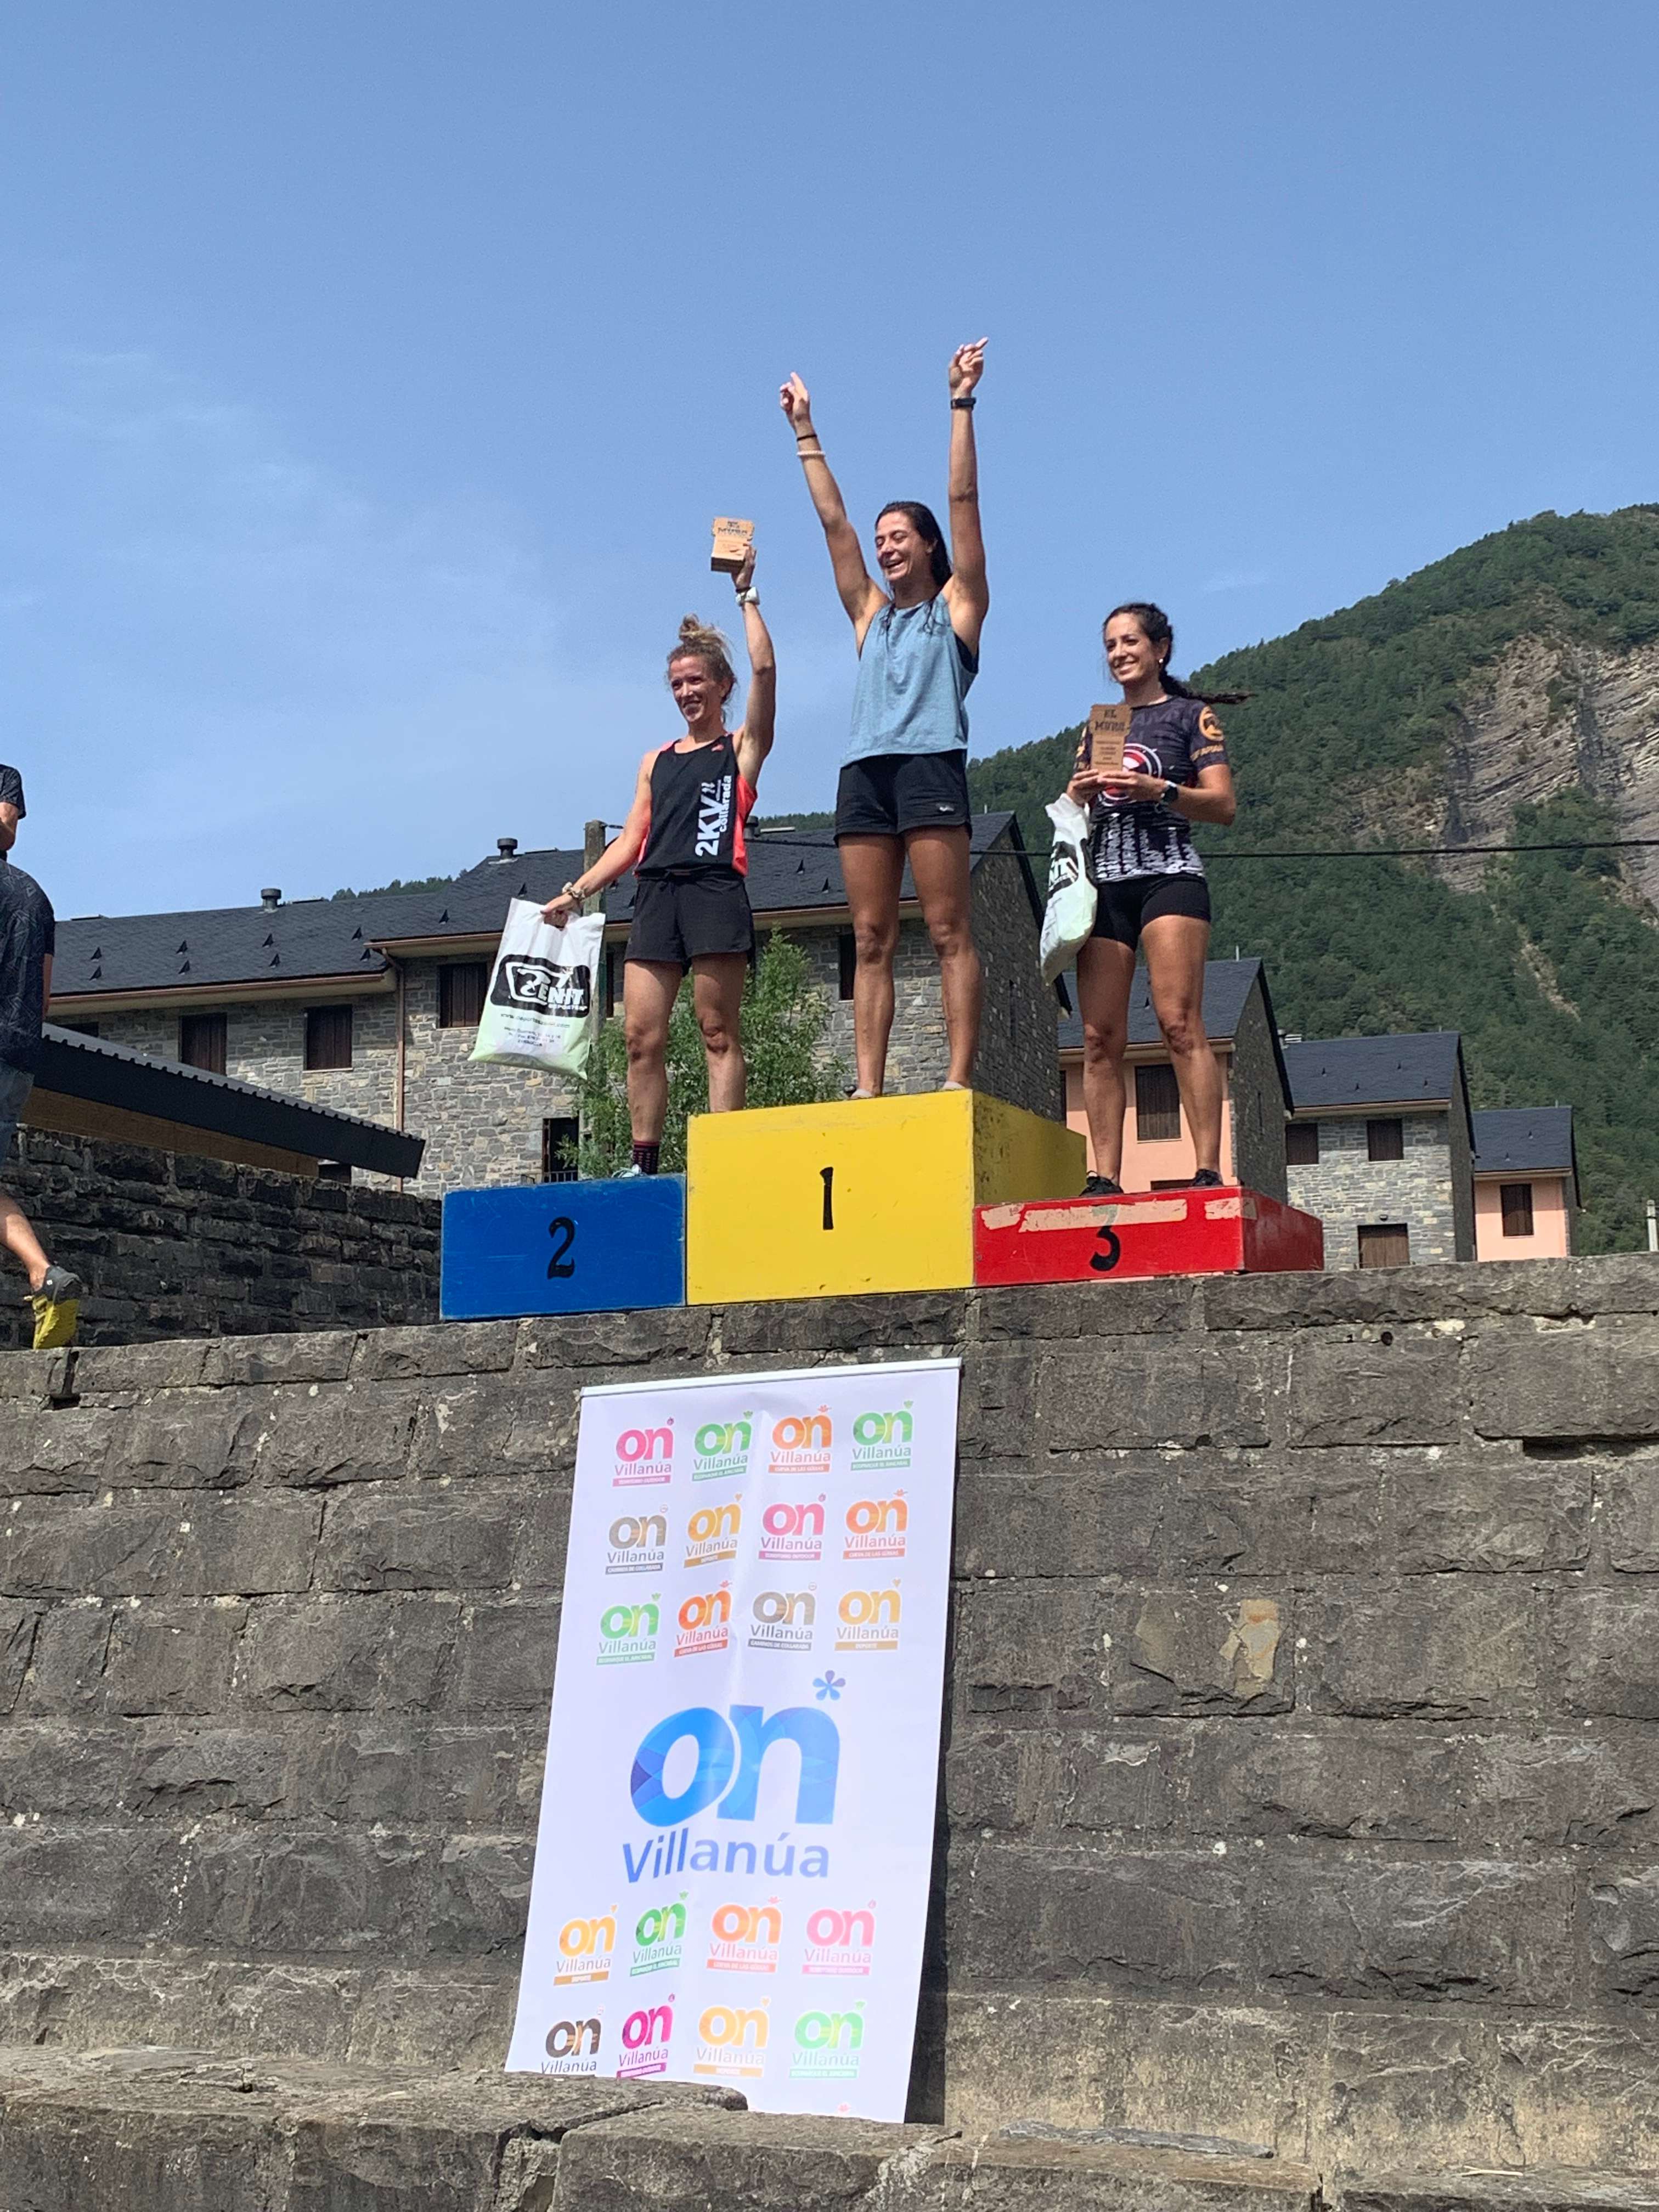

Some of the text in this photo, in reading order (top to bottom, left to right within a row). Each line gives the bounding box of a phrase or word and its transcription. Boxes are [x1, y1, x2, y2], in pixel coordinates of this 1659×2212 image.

[695, 794, 723, 856] 2KV
[819, 1166, 834, 1231] 1
[548, 1216, 575, 1280] 2
[1089, 1204, 1121, 1272] 3
[616, 1427, 673, 1462] on
[695, 1420, 752, 1457] on
[772, 1415, 832, 1450] on
[853, 1412, 913, 1446] on
[614, 1462, 672, 1476] Villanúa
[693, 1453, 748, 1471] Villanúa
[770, 1450, 831, 1464] Villanúa
[852, 1445, 911, 1460] Villanúa
[609, 1514, 667, 1549] on
[688, 1502, 741, 1542] on
[763, 1502, 825, 1536] on
[846, 1499, 907, 1534] on
[607, 1549, 664, 1564] Villanúa
[686, 1538, 737, 1557] Villanúa
[760, 1536, 822, 1550] Villanúa
[845, 1534, 906, 1549] Villanúa
[601, 1603, 659, 1640] on
[678, 1590, 732, 1630] on
[753, 1592, 816, 1625] on
[838, 1590, 901, 1625] on
[599, 1639, 656, 1654] Villanúa
[676, 1625, 729, 1645] Villanúa
[751, 1624, 813, 1640] Villanúa
[837, 1625, 899, 1640] Villanúa
[630, 1705, 840, 1827] on
[623, 1827, 829, 1883] Villanúa
[560, 1915, 616, 1956] on
[636, 1902, 686, 1946] on
[712, 1904, 782, 1944] on
[806, 1909, 874, 1946] on
[556, 1956, 611, 1973] Villanúa
[633, 1943, 681, 1963] Villanúa
[710, 1943, 777, 1960] Villanúa
[805, 1948, 871, 1963] Villanúa
[545, 2016, 601, 2058] on
[622, 2006, 673, 2049] on
[699, 2006, 768, 2047] on
[794, 2011, 863, 2050] on
[619, 2046, 668, 2067] Villanúa
